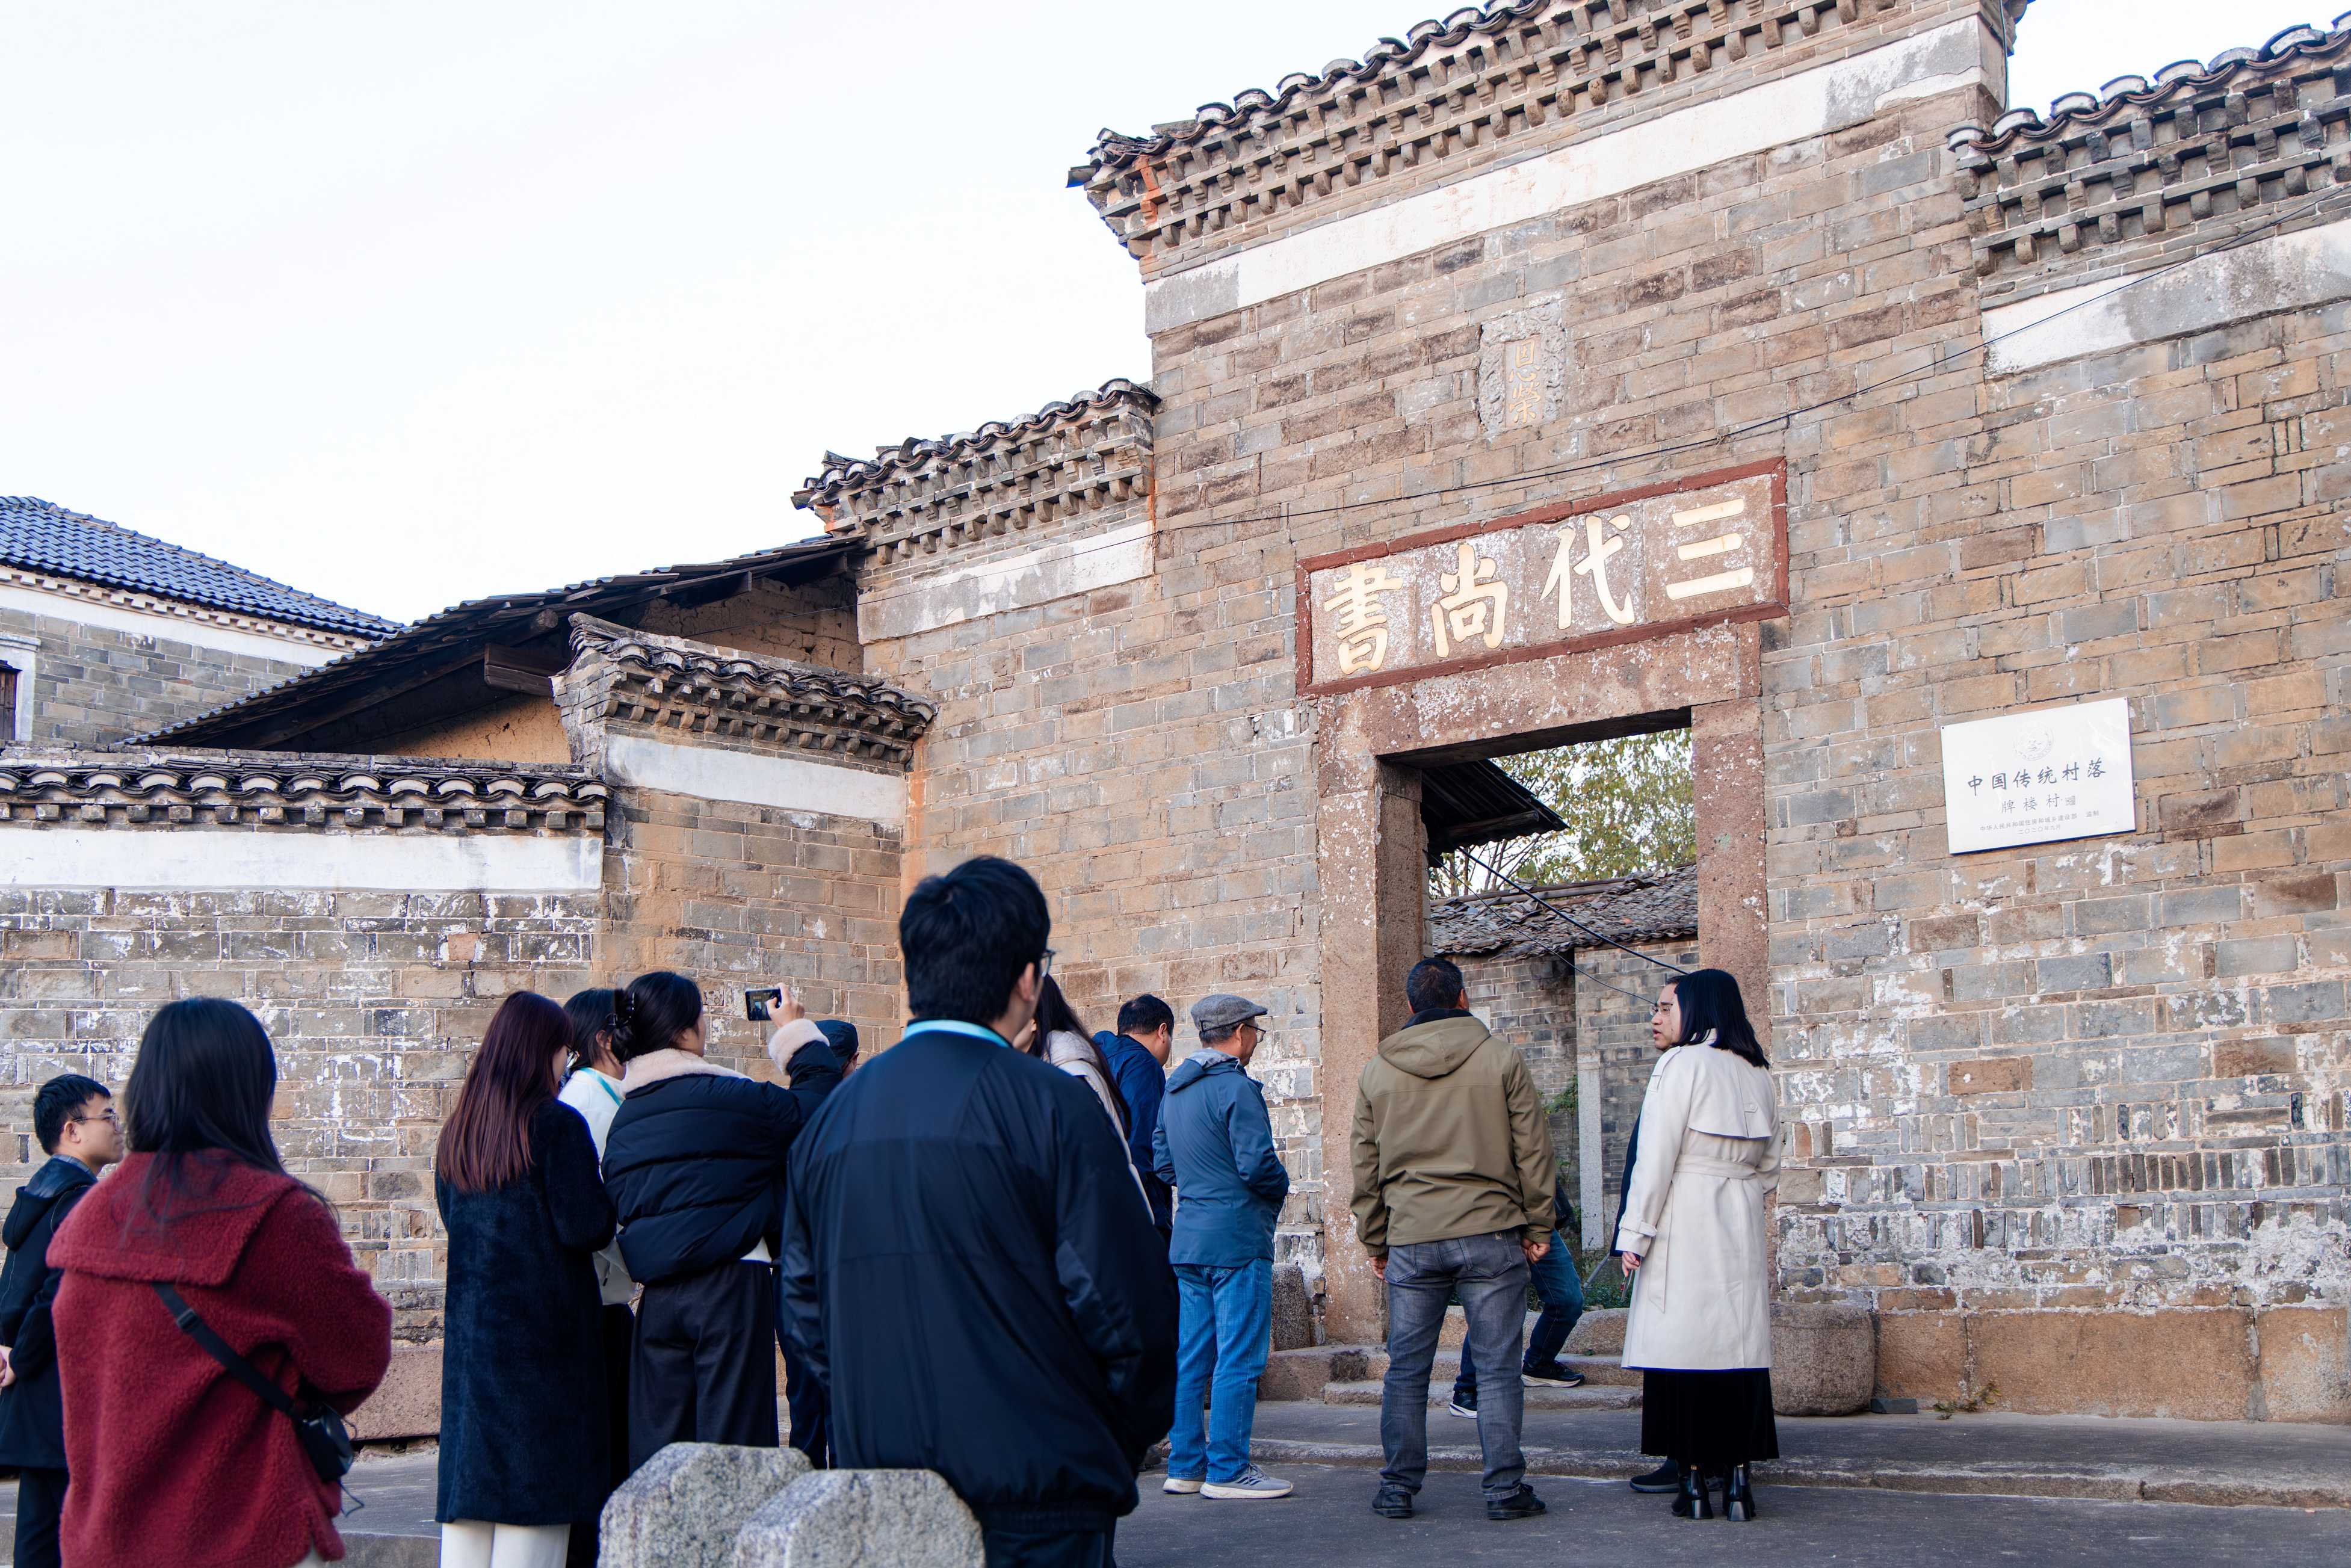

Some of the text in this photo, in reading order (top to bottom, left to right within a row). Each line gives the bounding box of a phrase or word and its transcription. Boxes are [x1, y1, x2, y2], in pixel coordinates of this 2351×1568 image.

[1968, 758, 2107, 796] 中国传统村落
[2001, 794, 2060, 813] 牌楼村
